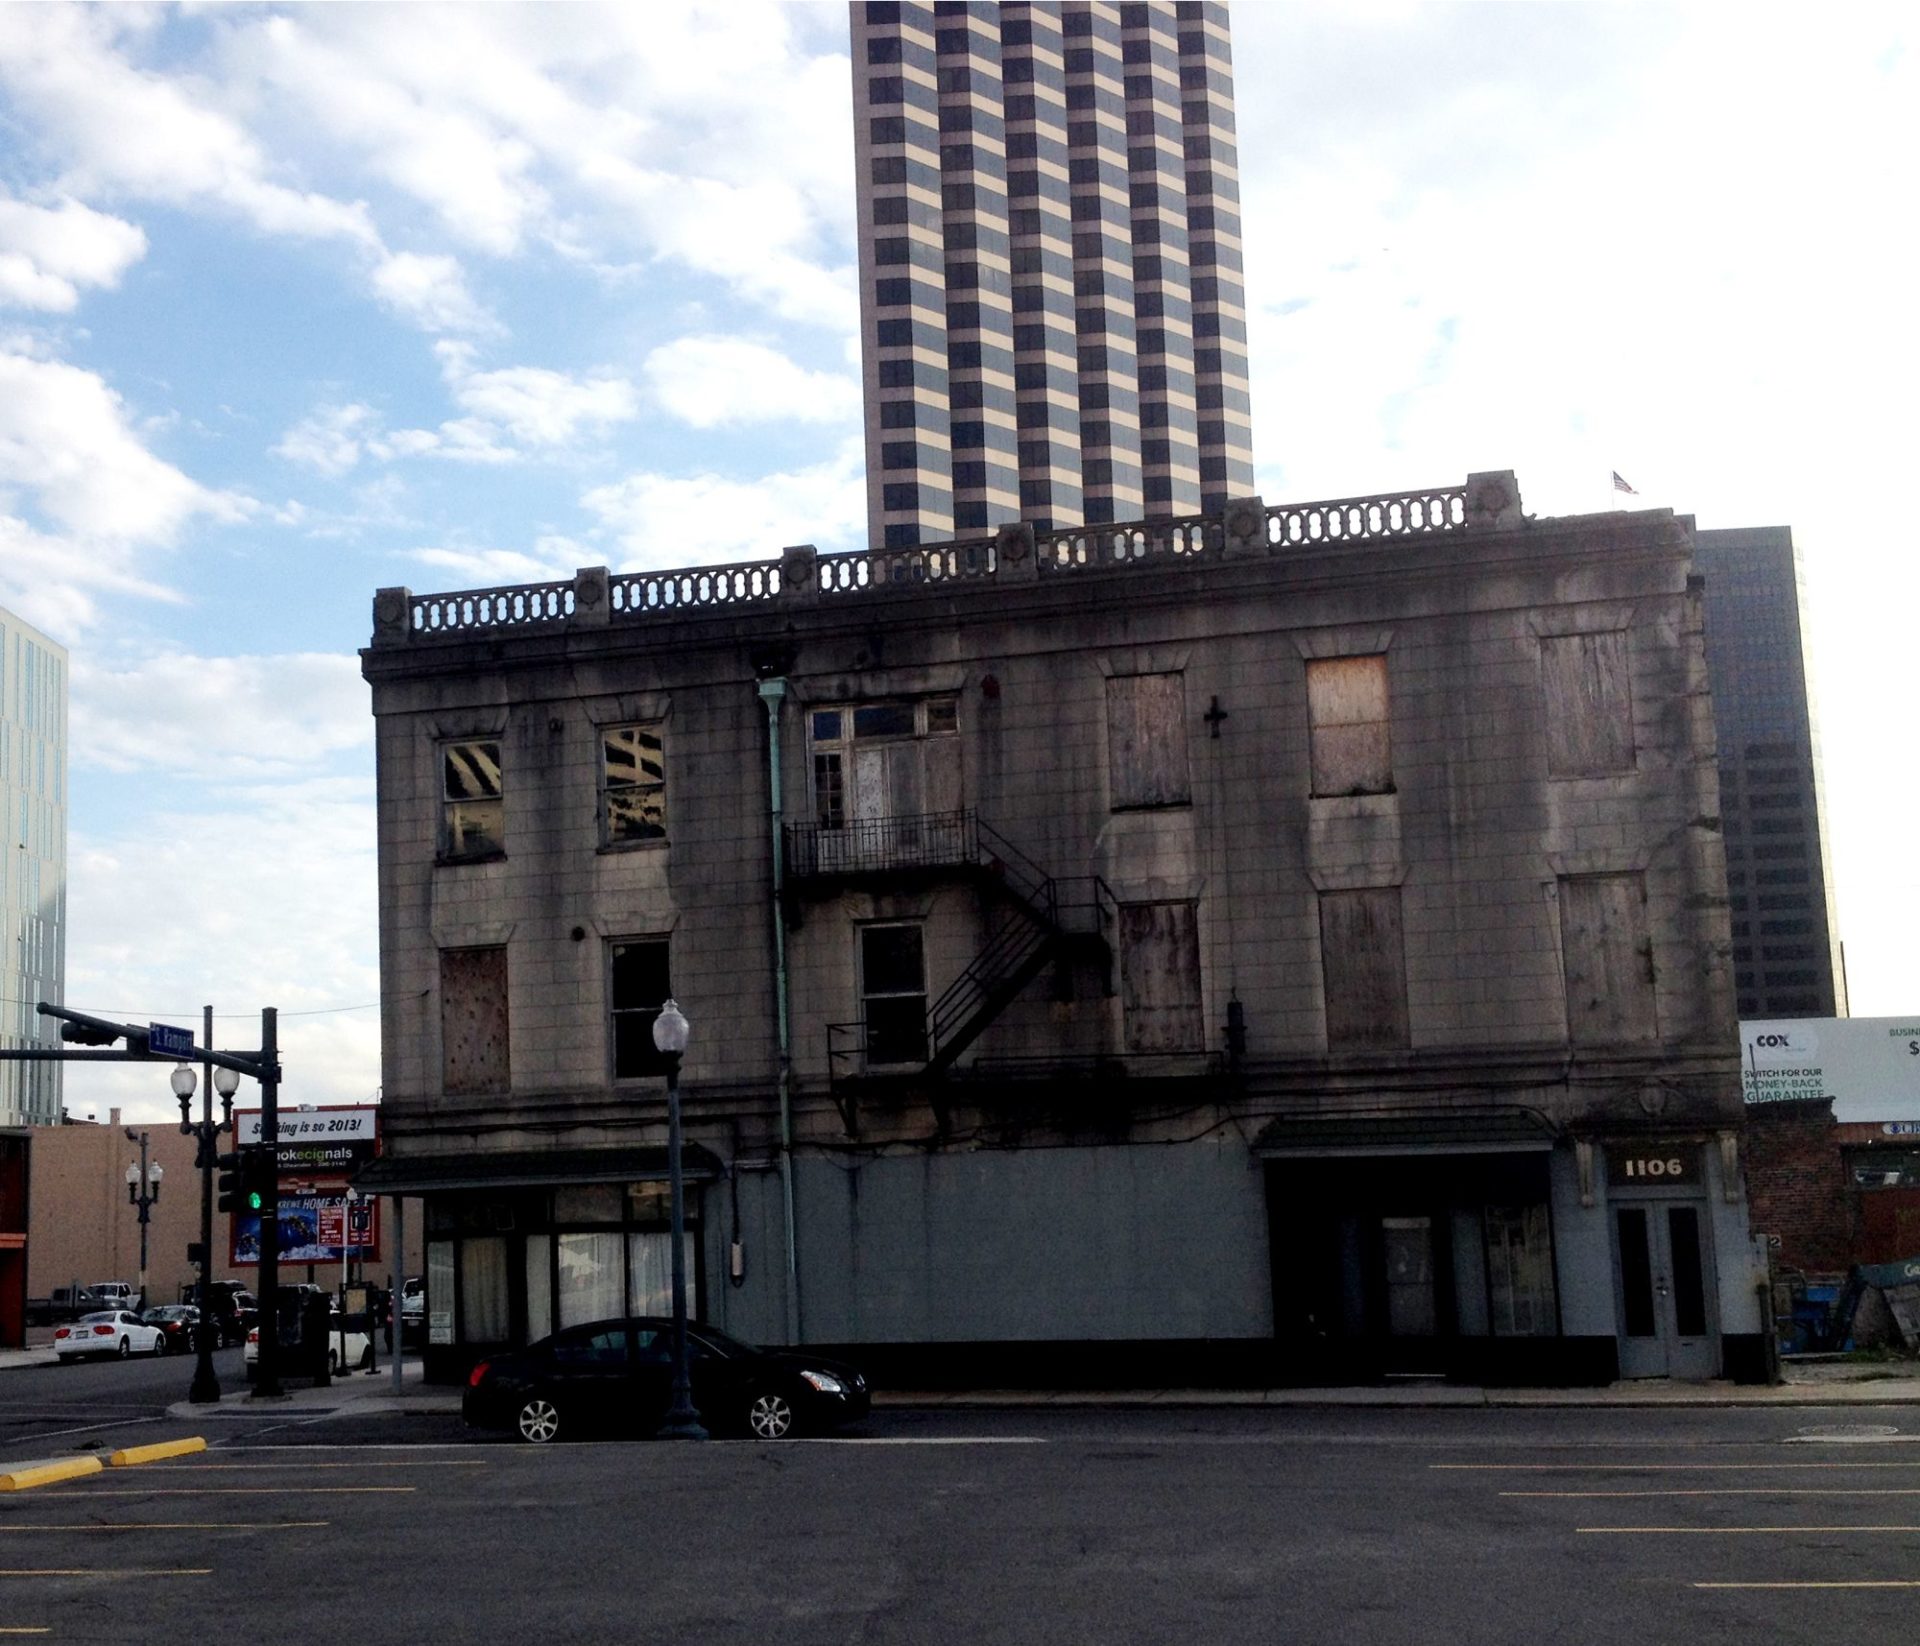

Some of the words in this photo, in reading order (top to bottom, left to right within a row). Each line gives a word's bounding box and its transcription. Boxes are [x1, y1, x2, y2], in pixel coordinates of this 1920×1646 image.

[1756, 1034, 1789, 1048] COX
[1744, 1069, 1780, 1079] SWITCH
[1782, 1069, 1800, 1078] FOR
[1802, 1068, 1822, 1077] OUR
[1745, 1078, 1823, 1090] MONEY-BACK
[300, 1120, 310, 1133] is
[311, 1122, 325, 1133] so
[327, 1119, 362, 1132] 2013!
[1626, 1158, 1683, 1176] 1106
[302, 1198, 331, 1210] HOME
